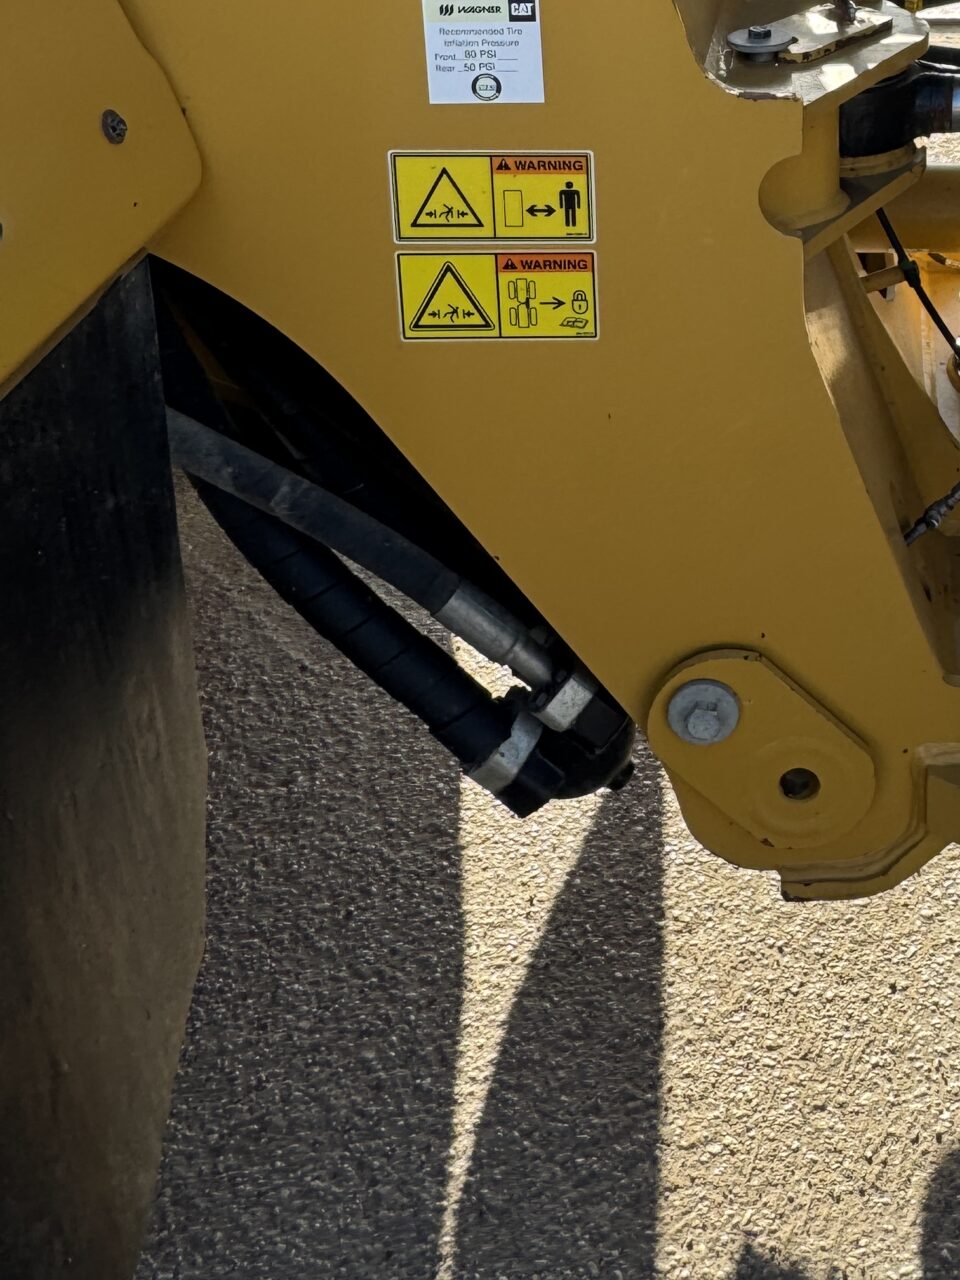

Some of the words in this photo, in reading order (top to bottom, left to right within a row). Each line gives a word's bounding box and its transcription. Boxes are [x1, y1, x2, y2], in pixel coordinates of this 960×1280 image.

[458, 5, 502, 14] WAGNER
[510, 2, 534, 16] CAT
[439, 27, 504, 36] Recommended
[481, 39, 520, 47] Pressure
[434, 53, 456, 61] Front
[479, 49, 497, 59] PSI
[514, 160, 584, 171] WARNING
[520, 259, 588, 271] WARNING
